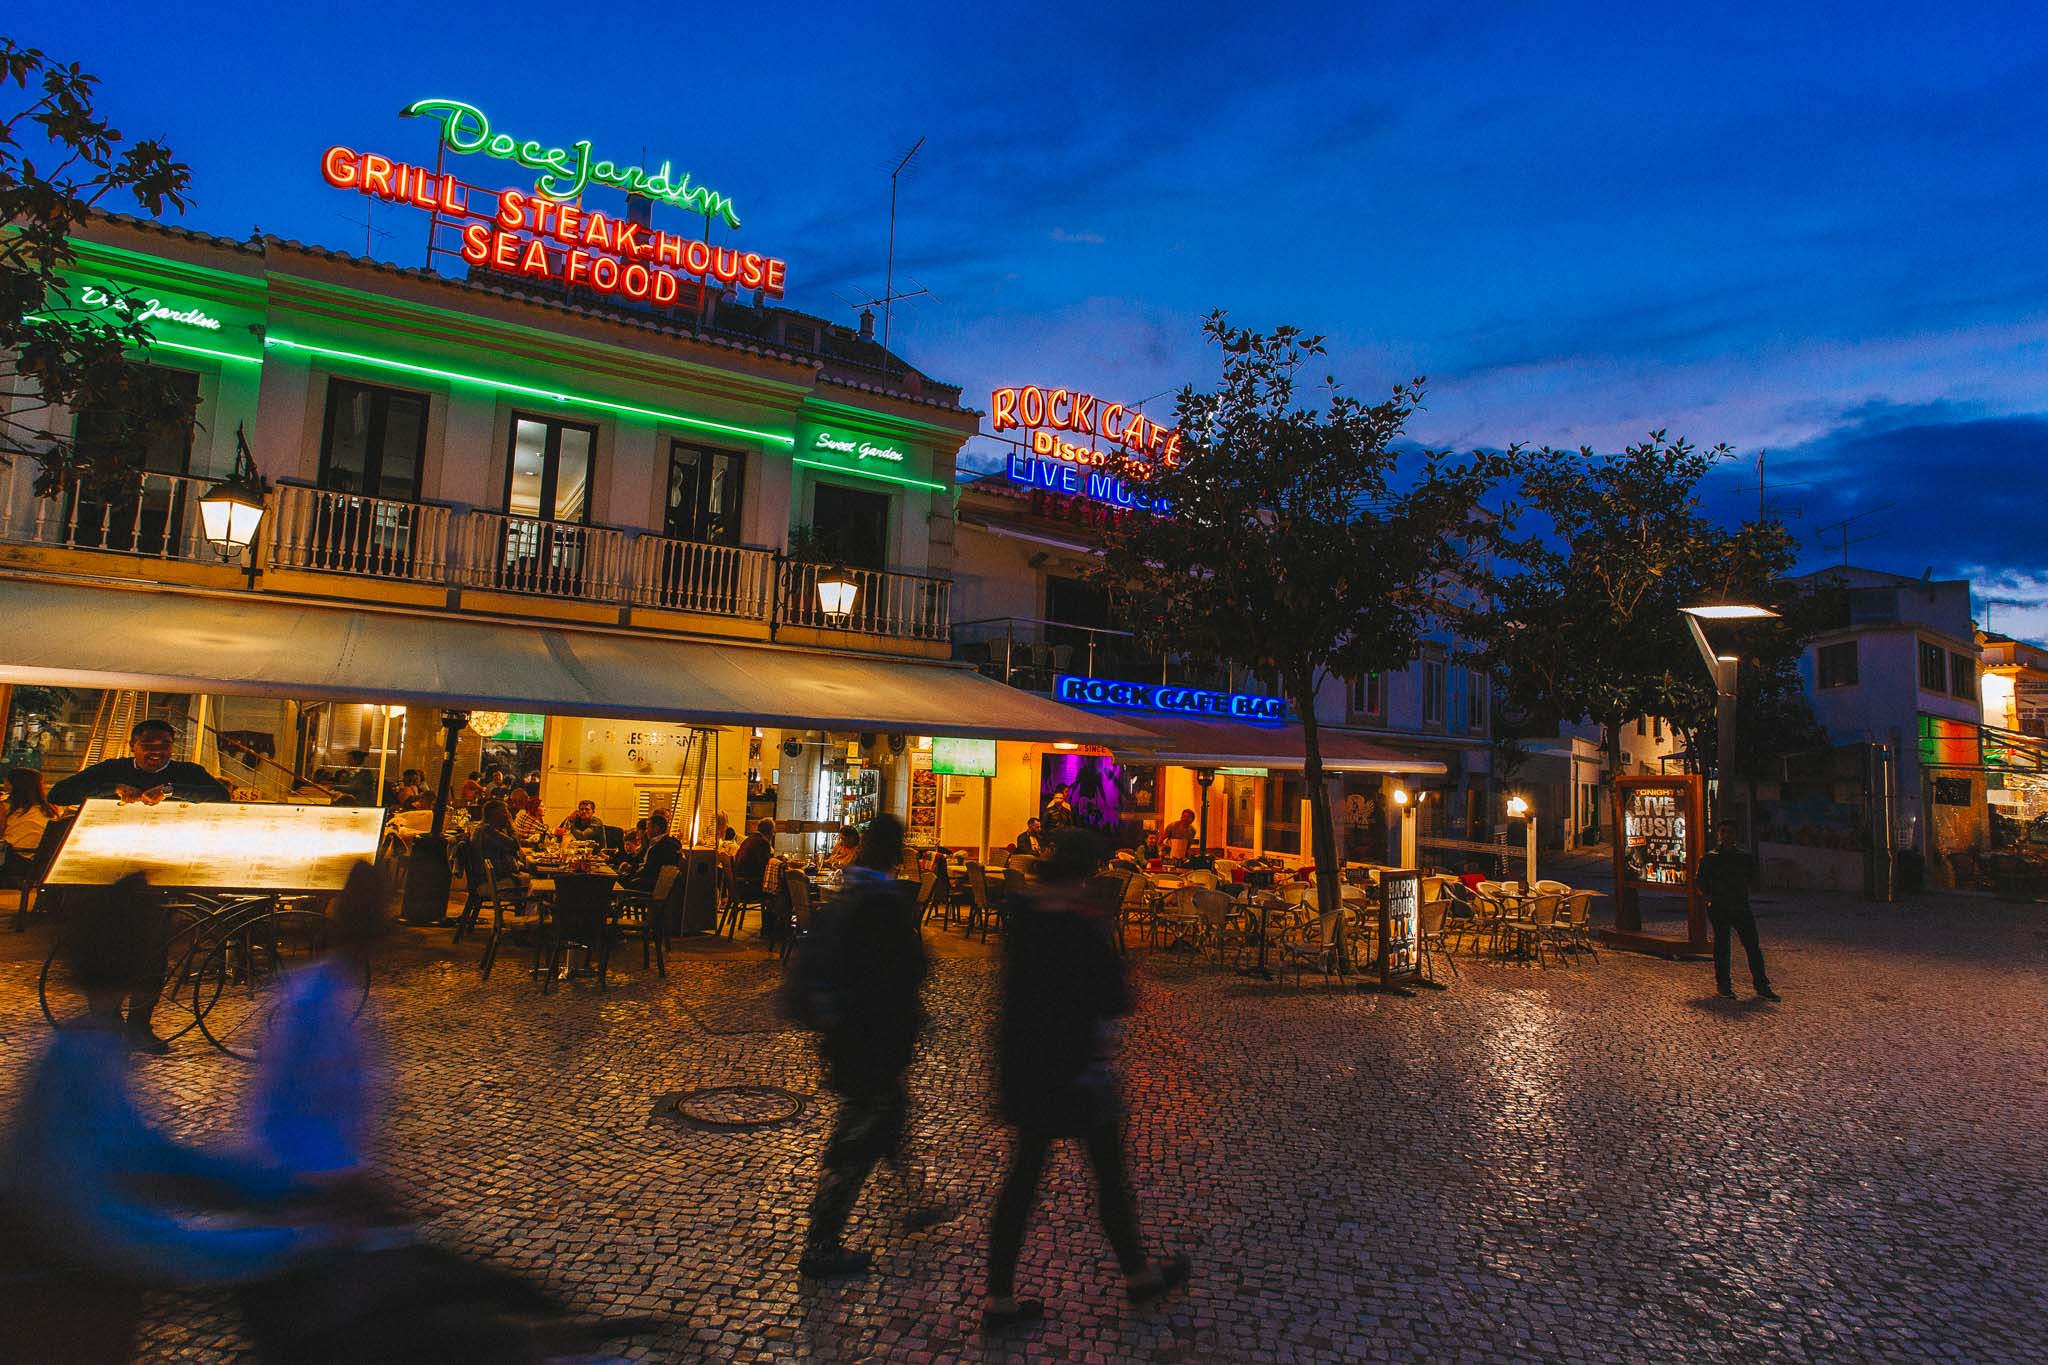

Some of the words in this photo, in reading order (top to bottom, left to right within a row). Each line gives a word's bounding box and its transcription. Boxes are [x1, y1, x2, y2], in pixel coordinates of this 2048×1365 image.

[321, 146, 467, 214] GRILL
[401, 98, 576, 180] Doce
[536, 140, 741, 229] Jardim
[461, 223, 549, 278] SEA
[565, 249, 681, 304] FOOD
[497, 190, 786, 300] STEAK-HOUSE
[992, 385, 1093, 435] ROCK
[816, 433, 857, 452] Sweet
[858, 443, 904, 461] Garden
[1033, 430, 1109, 467] Disco
[1007, 453, 1078, 495] LIVE
[1062, 677, 1152, 706] ROCK
[1156, 688, 1230, 714] CAFE
[1231, 695, 1287, 720] BAR
[1633, 796, 1676, 817] LIVE
[1634, 788, 1674, 797] TONIGHT
[1625, 816, 1686, 838] MUSIC
[1388, 878, 1417, 899] HAPPY
[1391, 898, 1414, 916] HOUR
